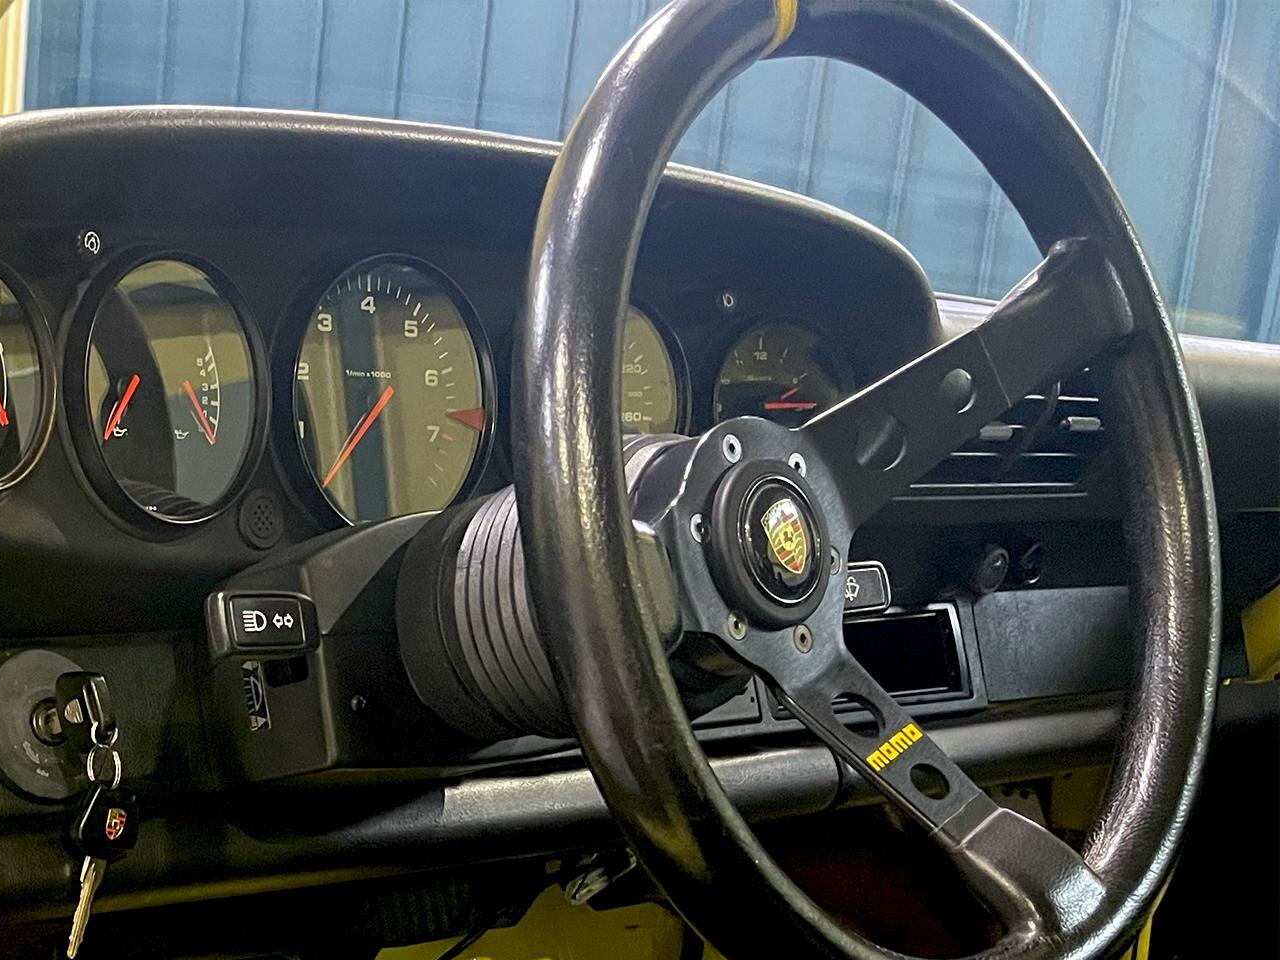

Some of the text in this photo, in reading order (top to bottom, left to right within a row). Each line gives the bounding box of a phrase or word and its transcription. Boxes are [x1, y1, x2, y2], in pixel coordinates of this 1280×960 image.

[360, 296, 376, 314] 4
[317, 313, 333, 332] 3
[404, 320, 419, 338] 5
[753, 351, 768, 361] 12
[297, 362, 309, 380] 2
[424, 370, 439, 386] 6
[299, 420, 305, 439] 1
[426, 426, 441, 443] 7
[865, 723, 923, 772] momo
